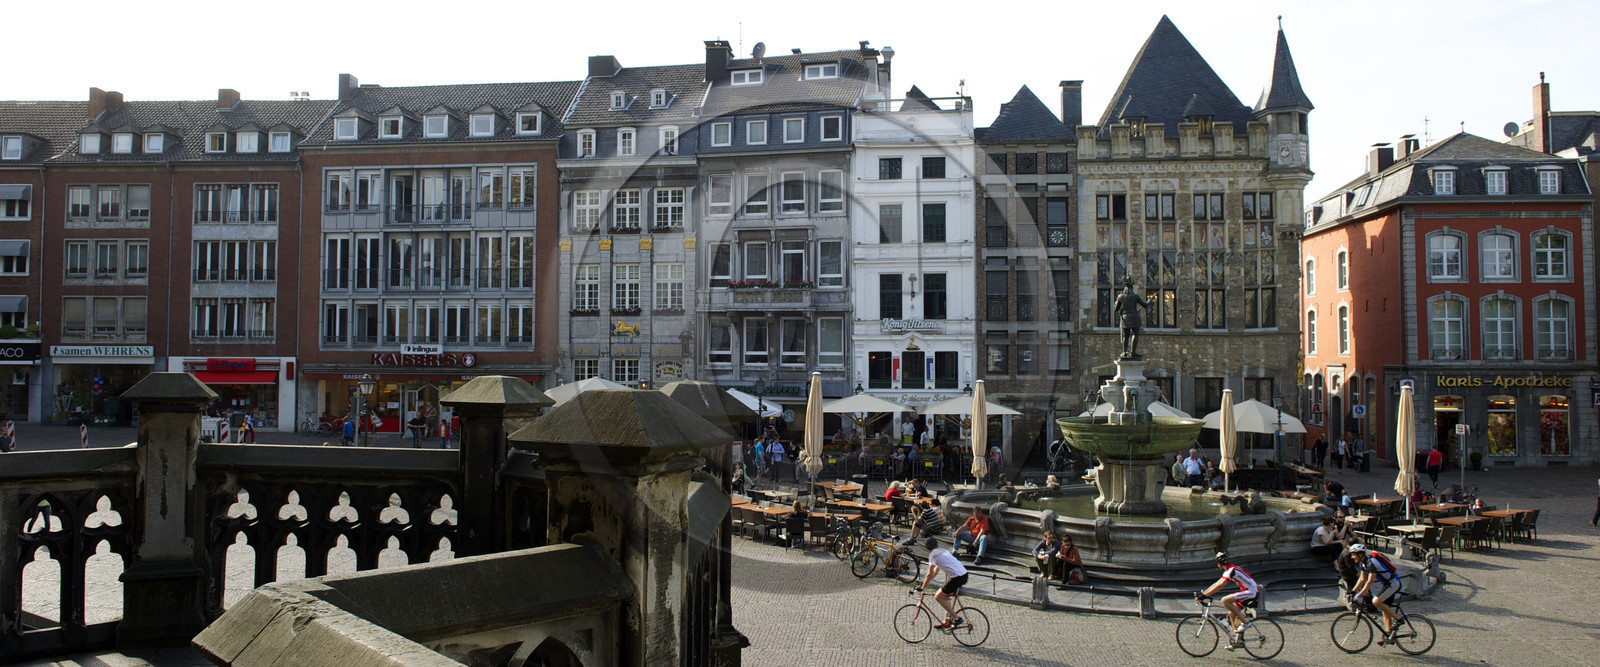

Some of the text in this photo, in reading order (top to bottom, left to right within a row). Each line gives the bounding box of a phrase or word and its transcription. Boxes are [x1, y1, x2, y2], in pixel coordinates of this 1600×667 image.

[60, 347, 150, 356] samen WEHRENS
[412, 345, 438, 353] inlingua
[371, 353, 457, 367] KAISER'S
[899, 393, 931, 403] Goldener
